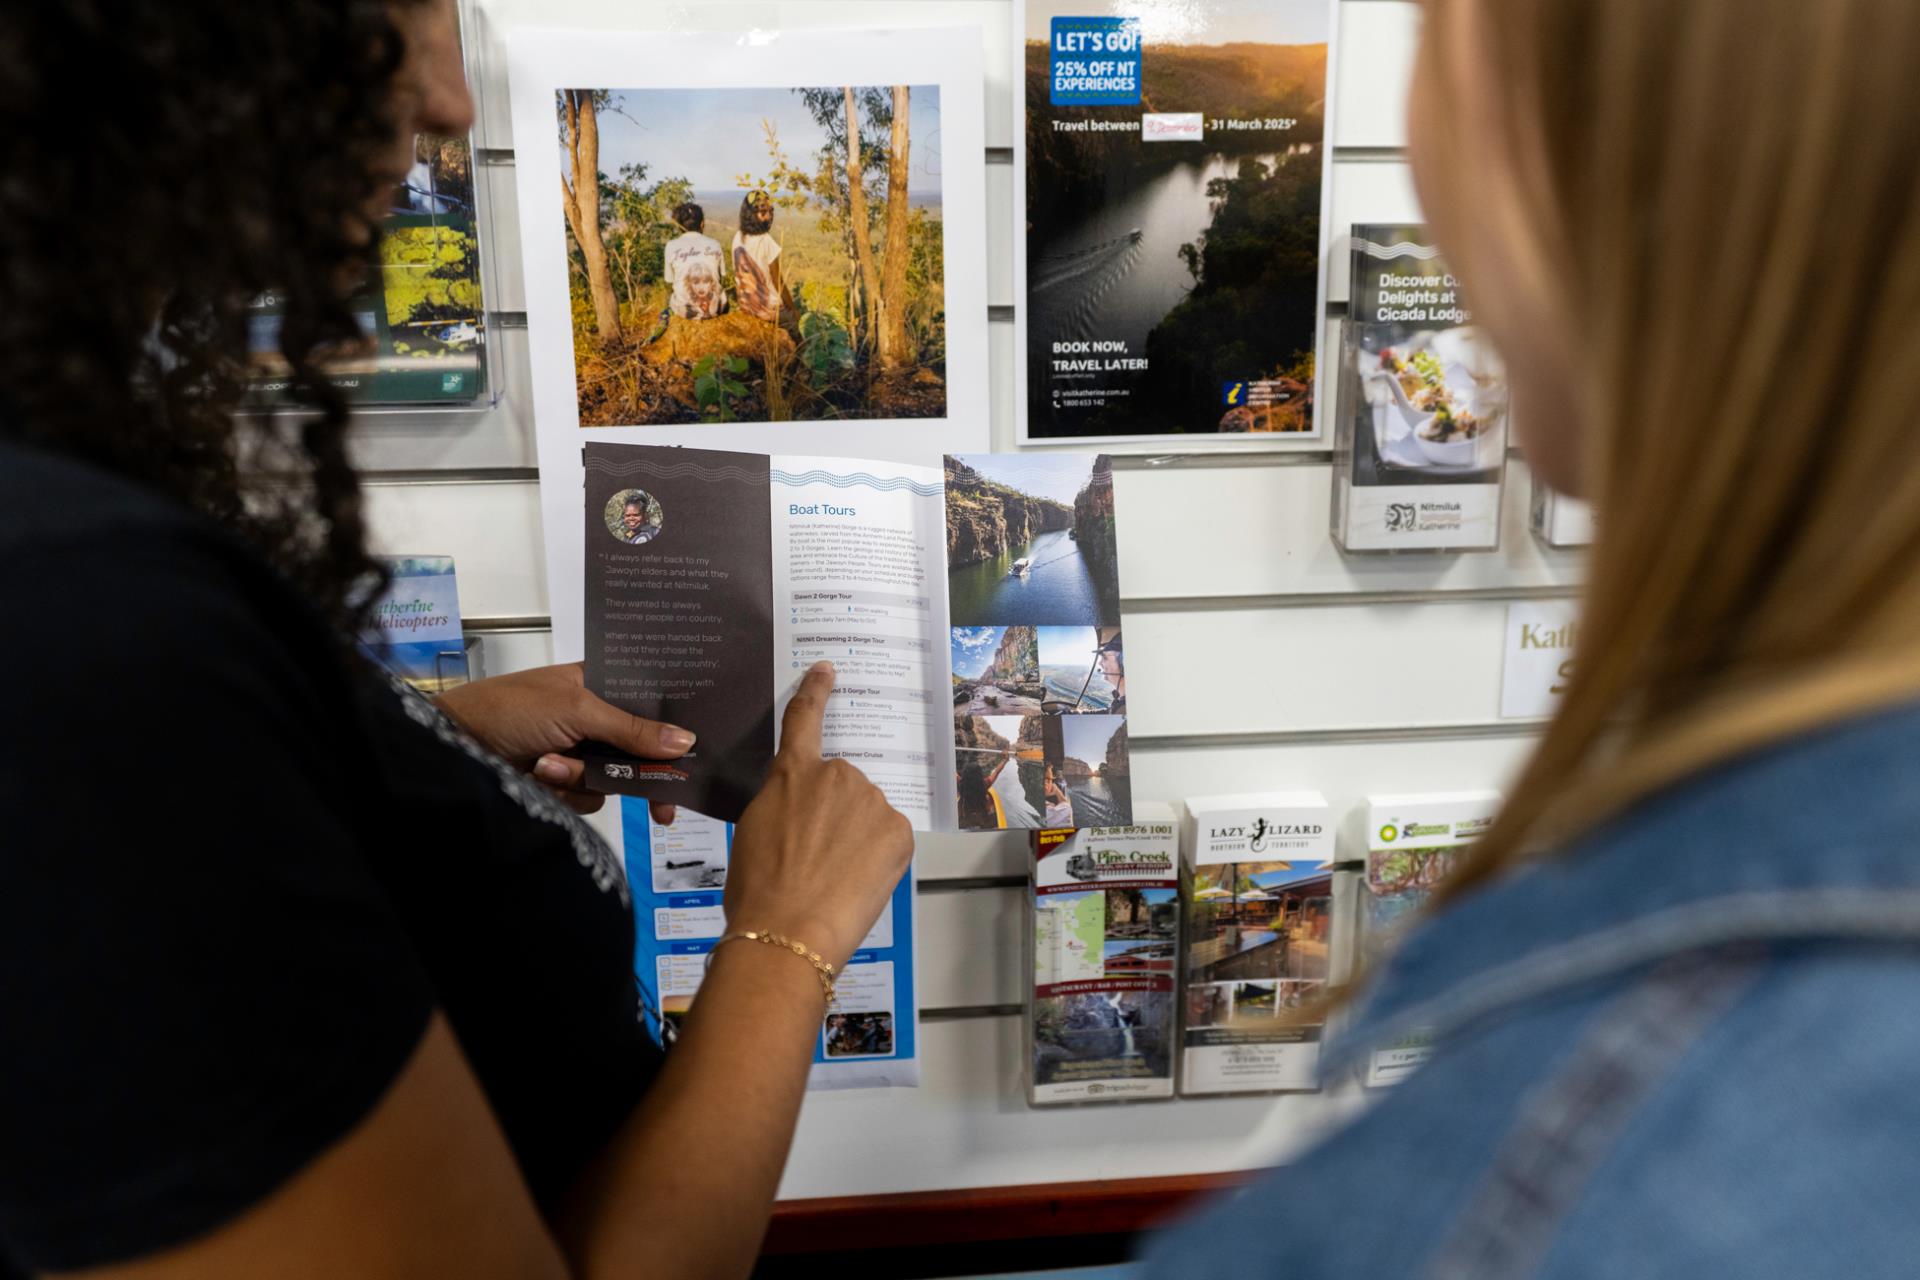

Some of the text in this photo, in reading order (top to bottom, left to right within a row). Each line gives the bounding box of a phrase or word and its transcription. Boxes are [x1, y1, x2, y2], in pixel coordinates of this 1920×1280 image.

[1056, 31, 1138, 52] LET'S GO!
[1055, 61, 1136, 77] 25% OFF NT
[1055, 77, 1135, 91] EXPERIENCES
[1052, 119, 1140, 132] Travel between
[1211, 119, 1225, 131] 31
[1227, 119, 1262, 131] March
[1379, 273, 1441, 288] Discover
[1378, 291, 1456, 306] Delights at
[1377, 307, 1426, 321] Cicada
[1052, 341, 1128, 354] BOOK NOW,
[1052, 358, 1148, 371] TRAVEL LATER!
[789, 504, 856, 516] Boat Tours
[1420, 503, 1461, 511] Nitmiluk
[610, 553, 639, 562] always
[664, 555, 683, 563] back
[686, 556, 694, 564] to
[696, 557, 709, 566] my
[641, 566, 667, 575] elders
[669, 568, 685, 576] and
[688, 568, 708, 577] what
[710, 570, 729, 579] they
[629, 580, 662, 588] wanted
[818, 593, 838, 601] Gorge
[605, 598, 701, 610] They wanted to always
[645, 614, 674, 623] people
[676, 615, 687, 623] on
[668, 632, 700, 642] handed
[702, 633, 723, 642] back
[816, 636, 847, 644] Dreaming
[620, 645, 639, 653] land
[661, 647, 687, 655] chose
[689, 647, 704, 655] the
[667, 660, 683, 668] our
[644, 679, 658, 687] our
[660, 680, 694, 689] country
[695, 679, 714, 688] with
[1091, 826, 1173, 836] Ph: 08 8976 1001
[1210, 825, 1323, 838] LAZY LIZARD
[1098, 851, 1170, 865] Pine Creek
[1098, 983, 1111, 991] BAR
